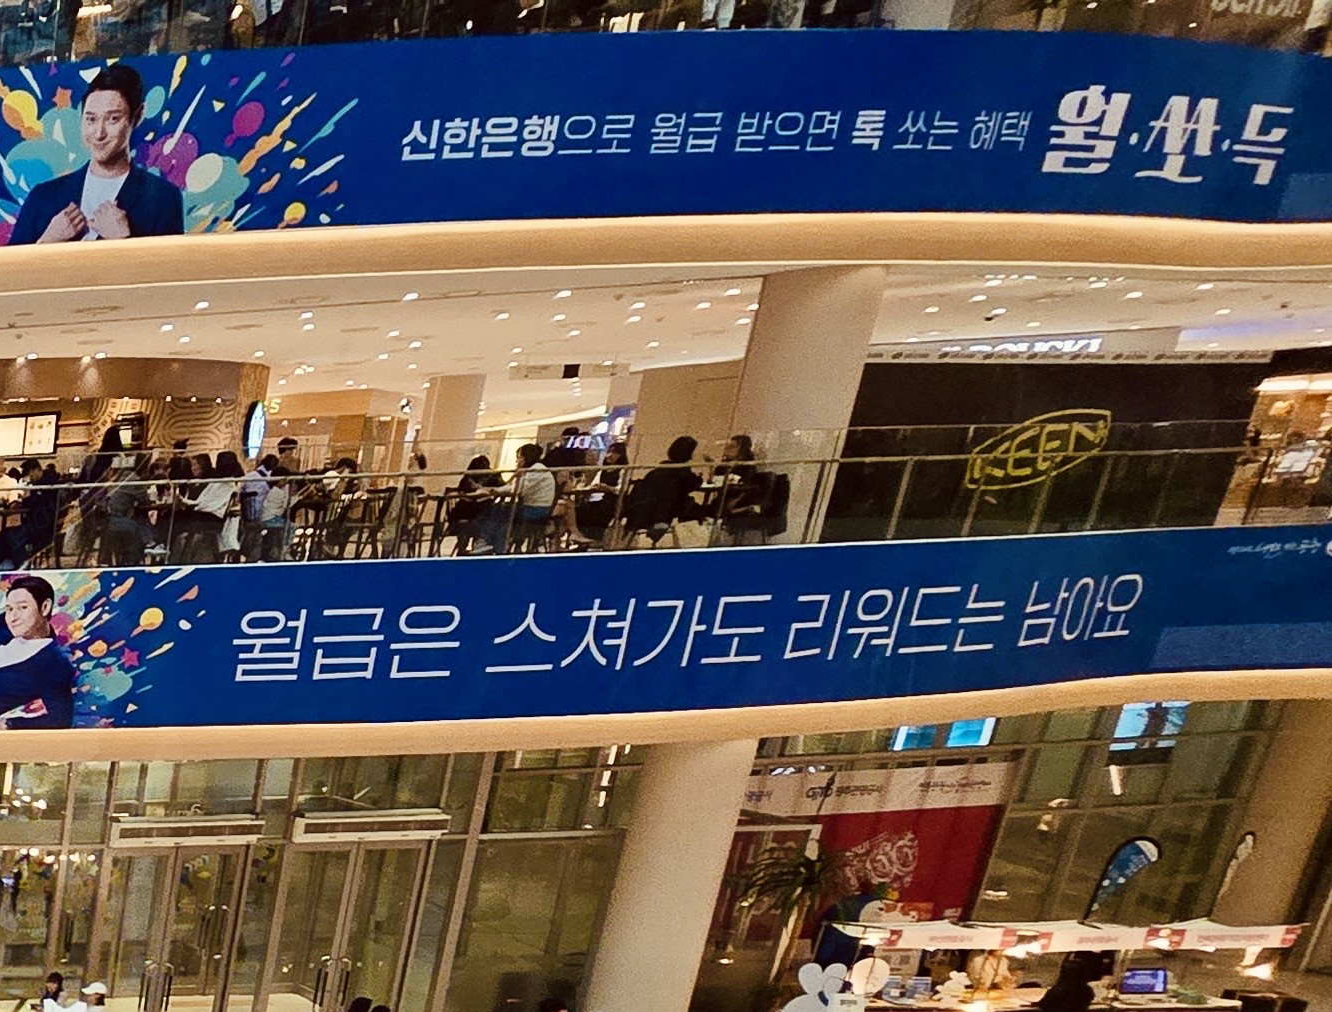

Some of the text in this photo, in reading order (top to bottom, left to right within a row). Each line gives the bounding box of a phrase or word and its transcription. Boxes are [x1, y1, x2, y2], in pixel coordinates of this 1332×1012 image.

[400, 113, 636, 162] 신한은행으로
[649, 108, 723, 155] 월급
[735, 107, 841, 154] 받으면
[850, 107, 886, 153] 톡
[893, 108, 961, 153] 쏘는
[969, 107, 1033, 153] 혜택
[972, 419, 1108, 479] KEEN
[231, 573, 1146, 686] 월급은 스쳐가도 리워드는 남아요
